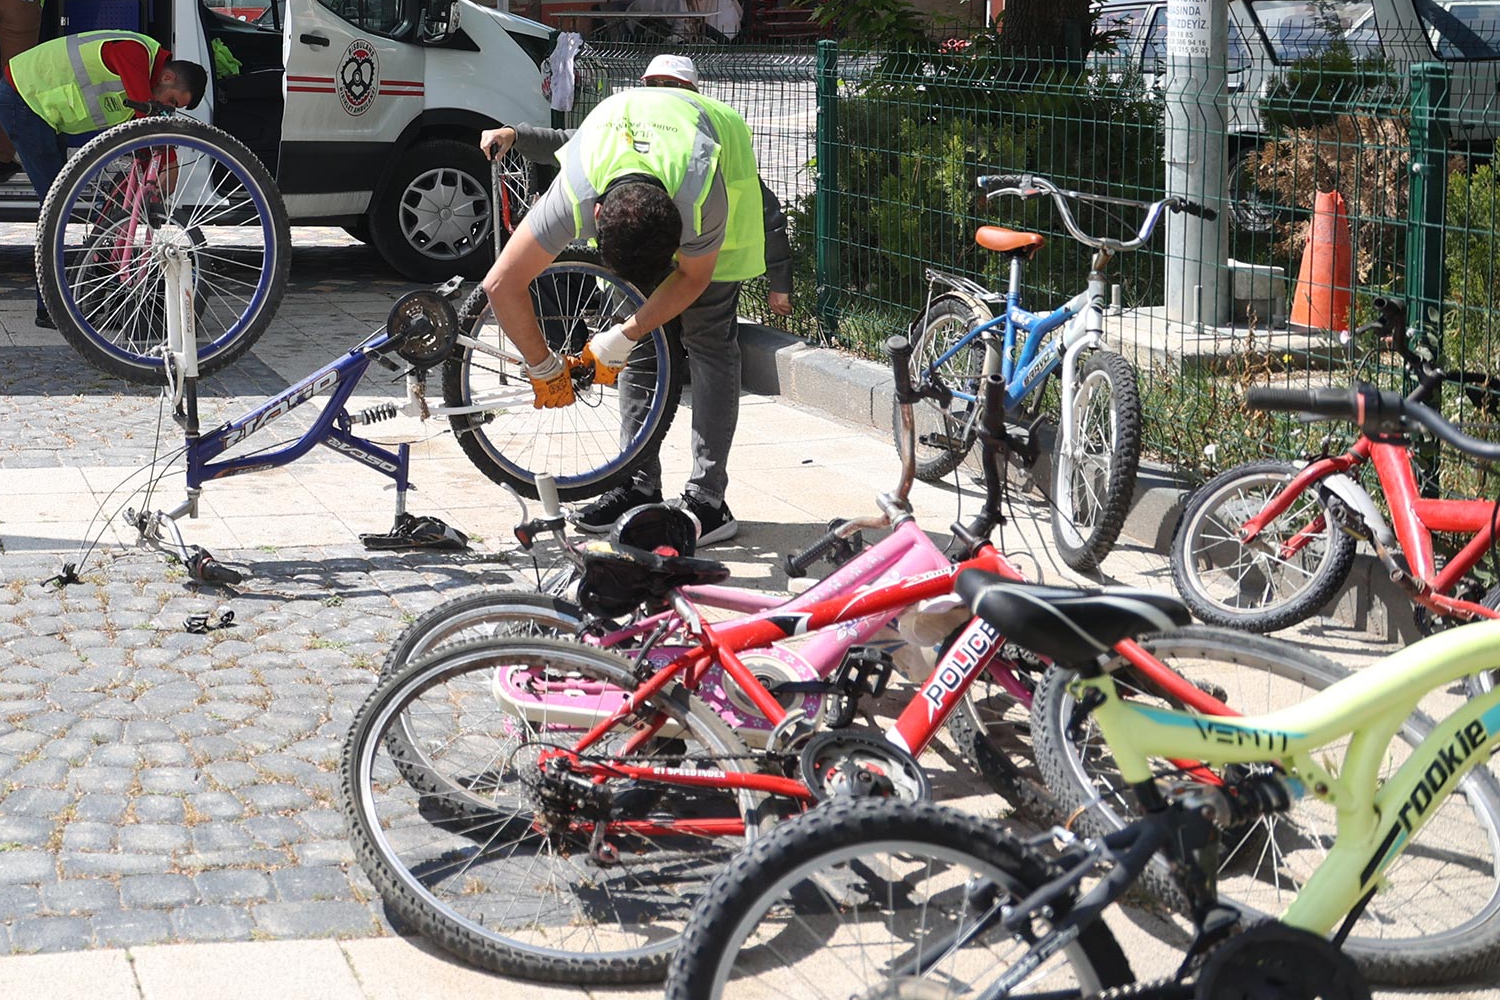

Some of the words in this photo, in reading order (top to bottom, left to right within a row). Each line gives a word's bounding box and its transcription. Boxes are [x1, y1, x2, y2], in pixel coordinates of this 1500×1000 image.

[666, 767, 697, 776] SPEED
[697, 769, 726, 778] INDEX
[1396, 718, 1487, 835] rookie
